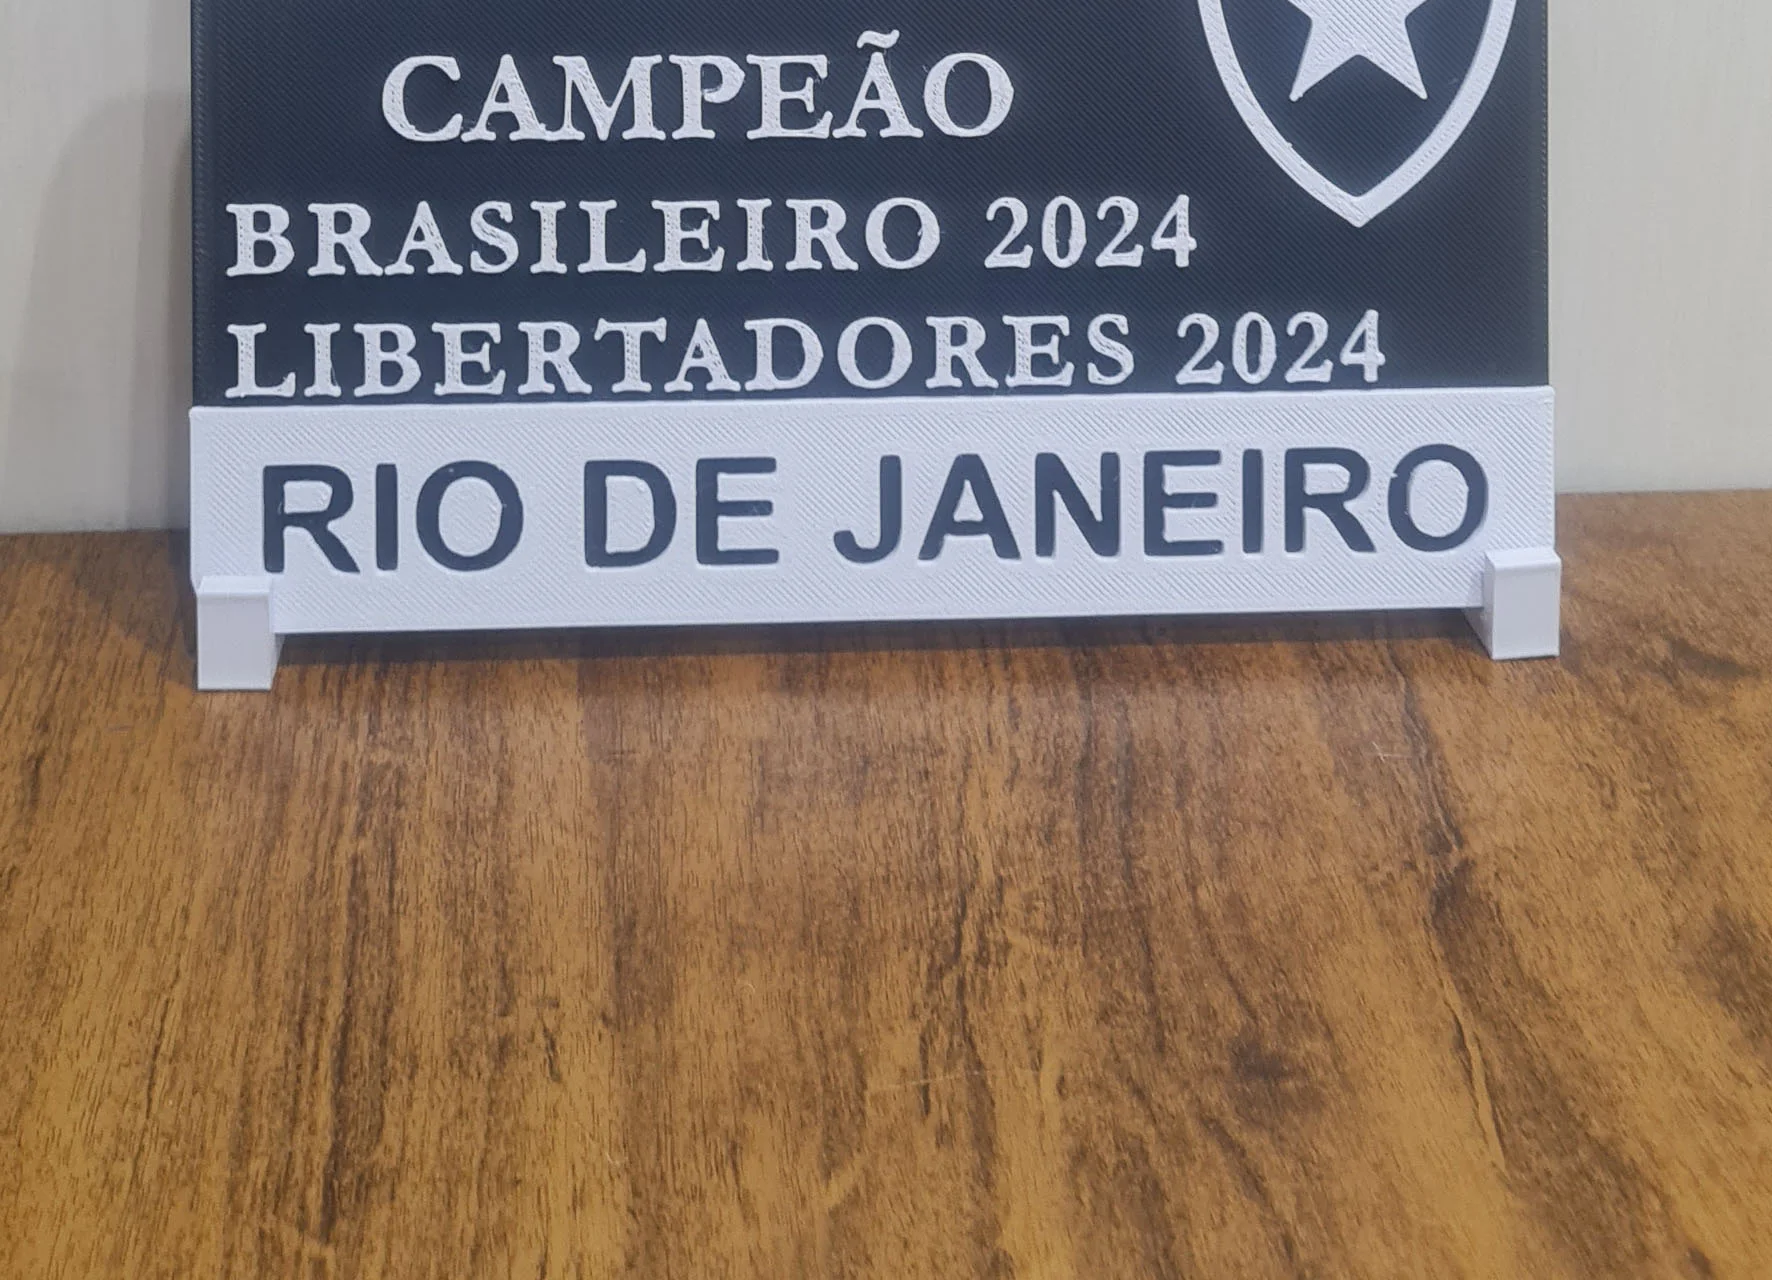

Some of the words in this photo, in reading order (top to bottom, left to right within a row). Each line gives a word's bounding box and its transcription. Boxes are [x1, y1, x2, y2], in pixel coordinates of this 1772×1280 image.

[381, 30, 1015, 143] CAMPEÃO
[225, 196, 941, 277] BRASILEIRO
[983, 194, 1198, 269] 2024
[224, 313, 1135, 399] LIBERTADORES
[1175, 309, 1387, 386] 2024
[263, 460, 524, 573] RIO
[584, 457, 779, 568] DE
[834, 444, 1487, 563] JANEIRO
